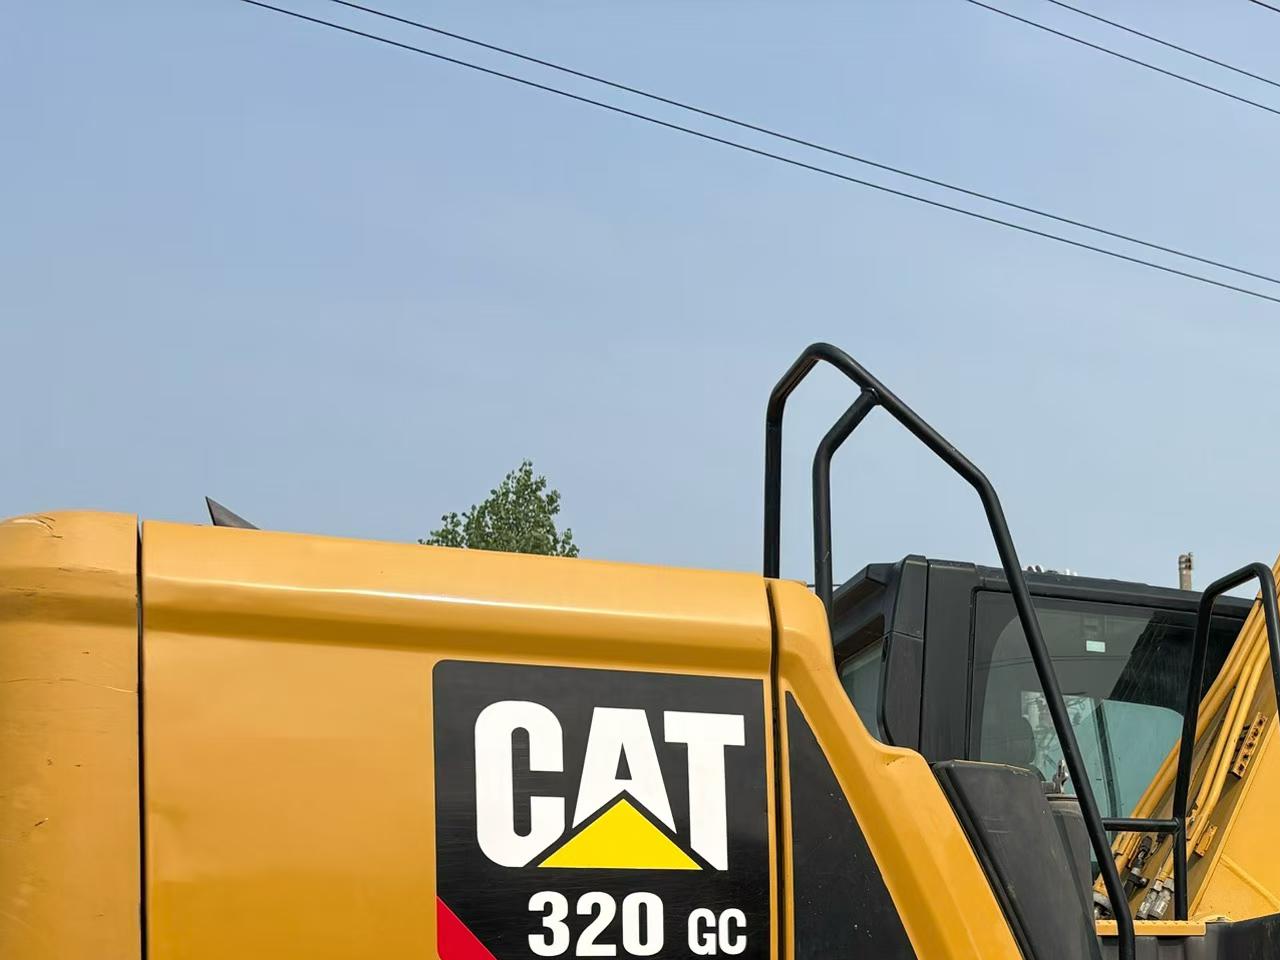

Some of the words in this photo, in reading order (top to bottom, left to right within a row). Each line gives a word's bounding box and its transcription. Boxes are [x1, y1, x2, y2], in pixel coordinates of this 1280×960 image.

[474, 700, 746, 871] CAT
[528, 891, 664, 957] 320
[687, 907, 747, 956] GC
